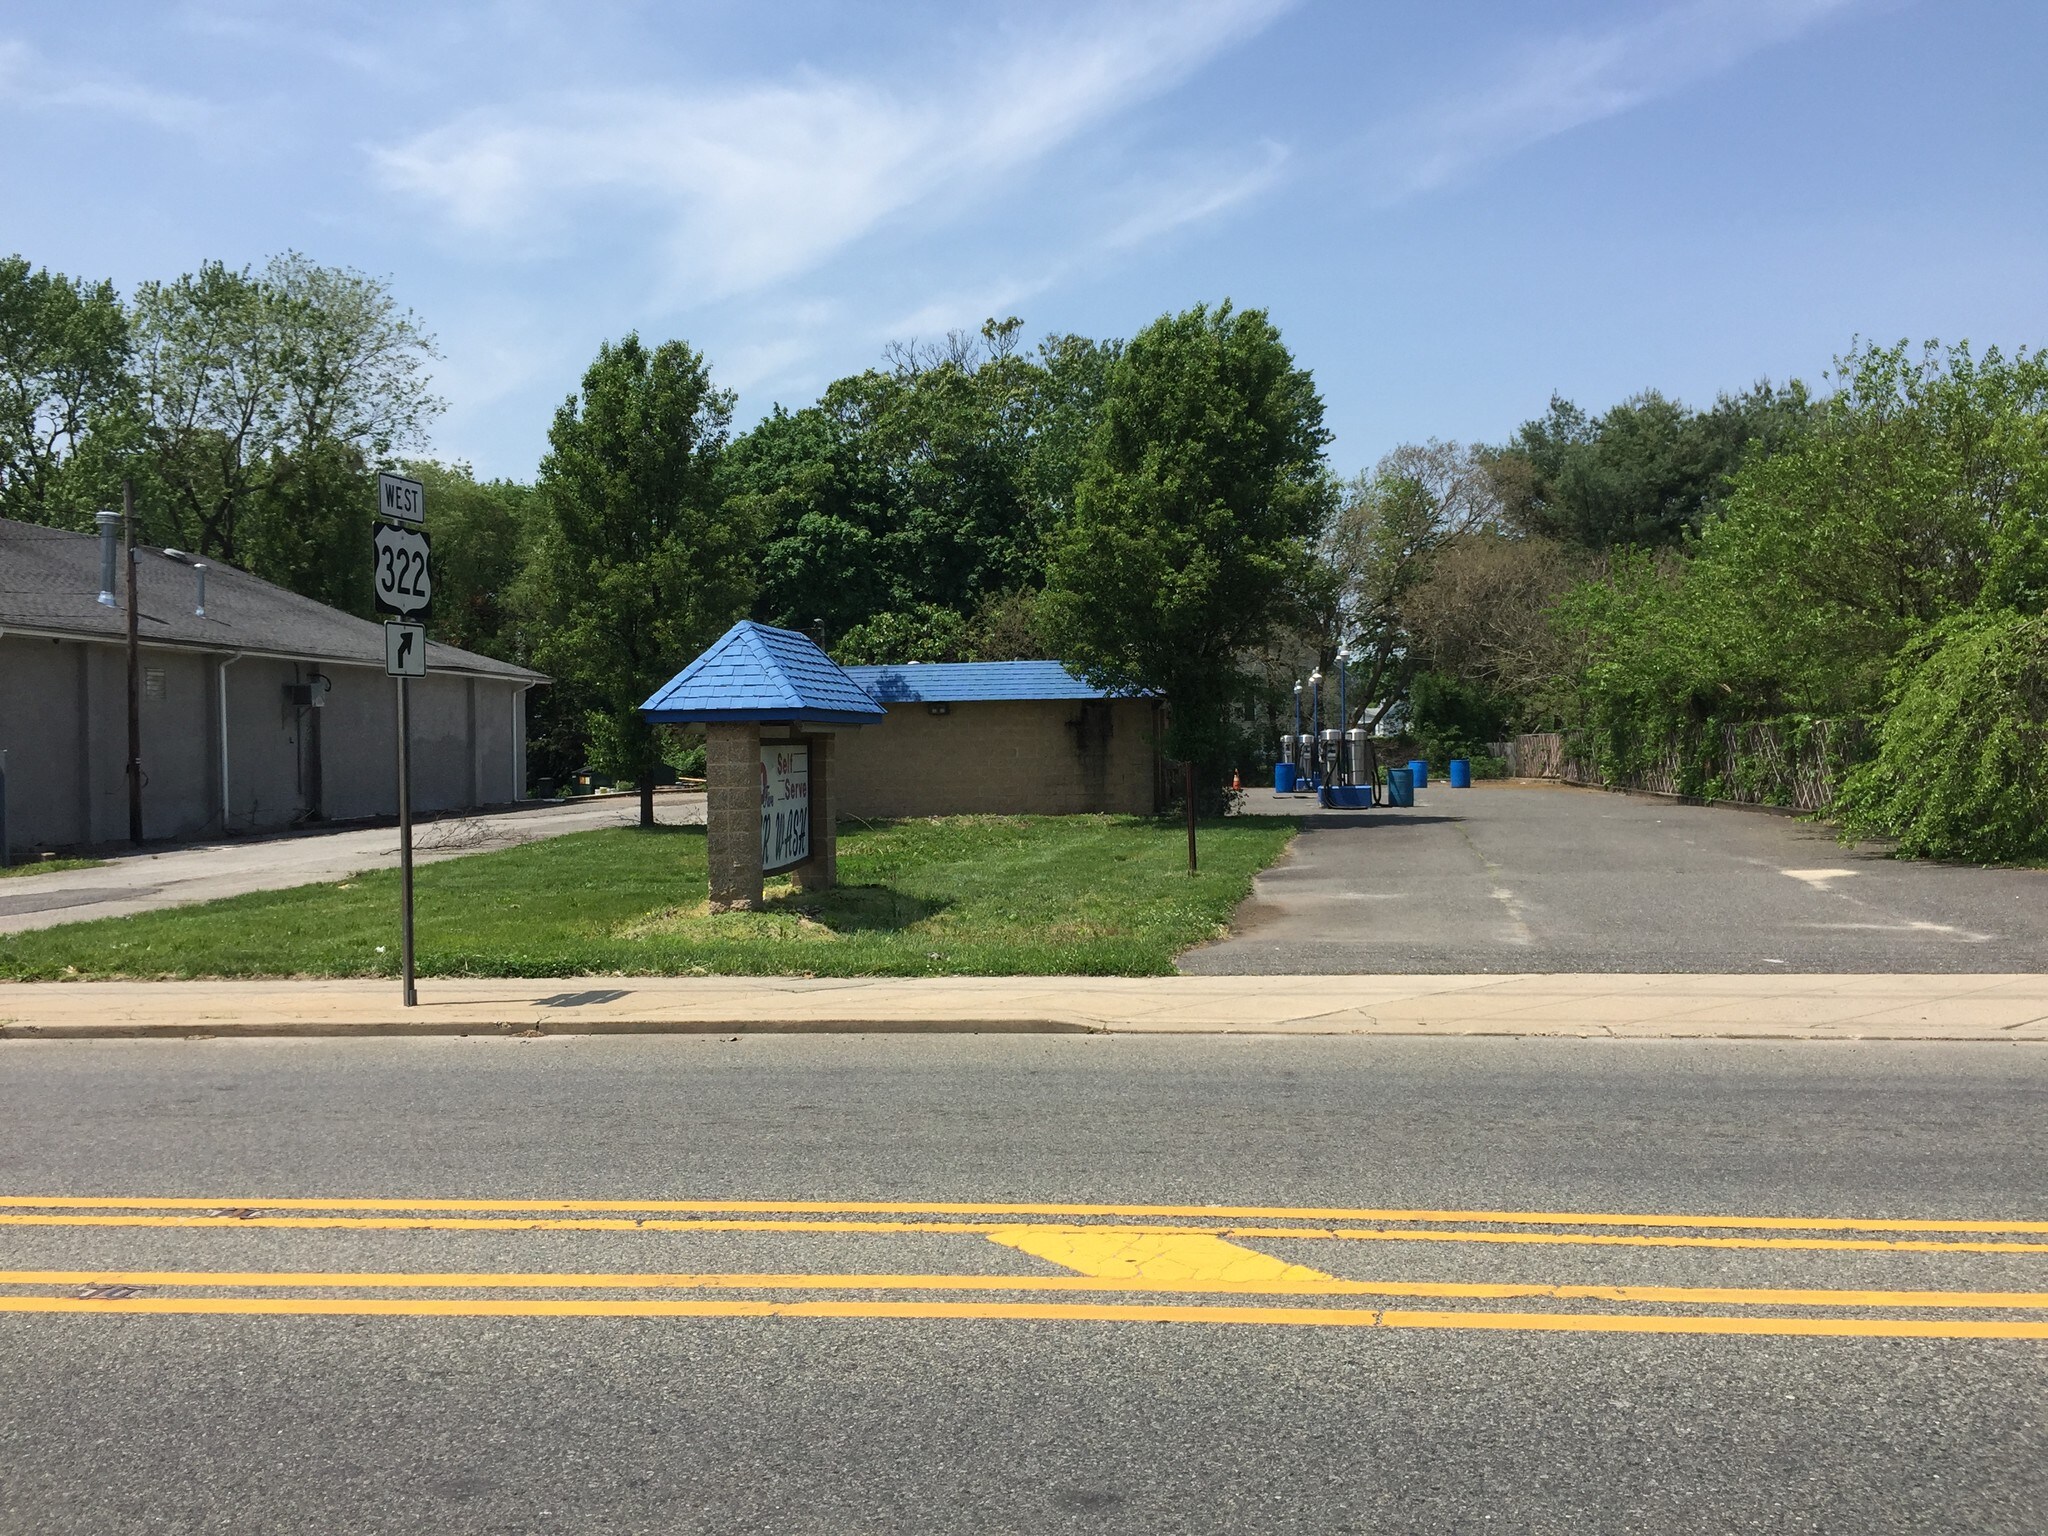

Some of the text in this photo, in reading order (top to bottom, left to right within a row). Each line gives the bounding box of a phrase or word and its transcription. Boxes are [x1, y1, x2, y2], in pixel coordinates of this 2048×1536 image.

[384, 483, 418, 513] WEST
[381, 545, 426, 597] 322
[777, 753, 793, 775] Self
[785, 778, 807, 800] Serve
[775, 807, 807, 861] WASH
